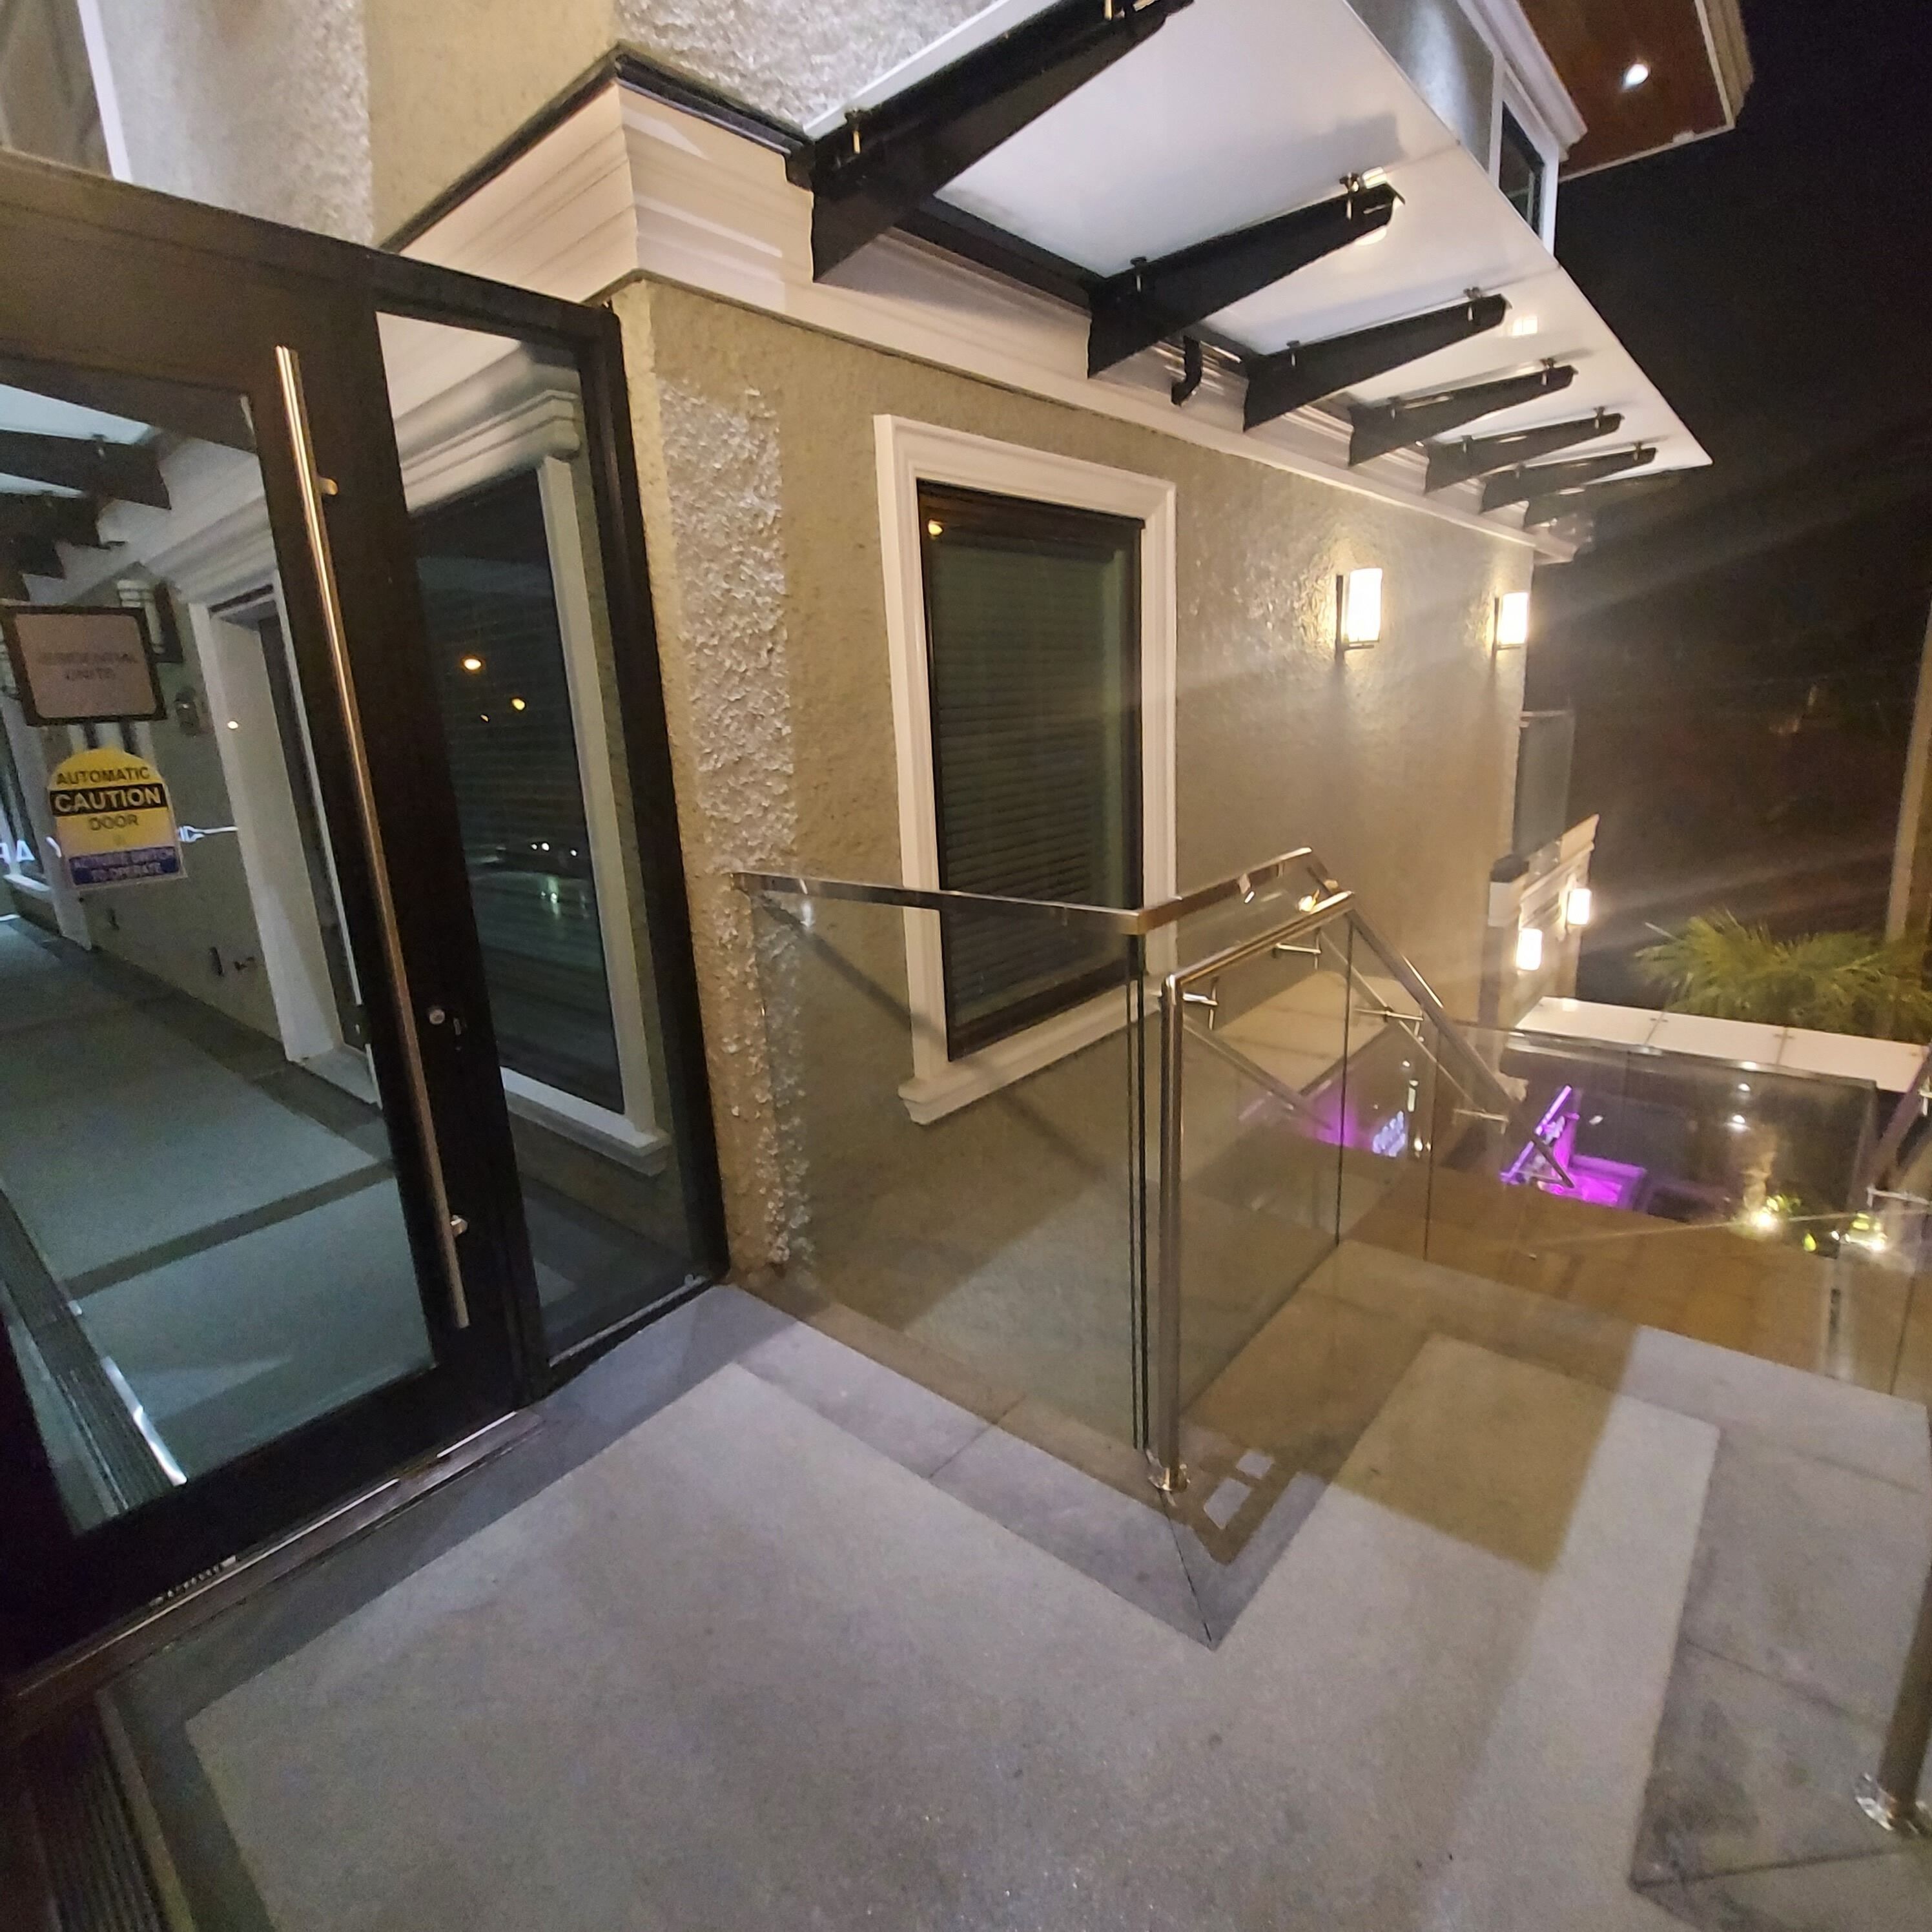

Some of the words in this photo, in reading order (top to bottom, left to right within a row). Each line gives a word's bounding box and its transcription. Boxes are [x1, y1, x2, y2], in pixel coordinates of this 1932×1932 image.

[56, 766, 150, 785] AUTOMATIC
[55, 786, 161, 812] CAUTION
[89, 814, 139, 830] DOOR
